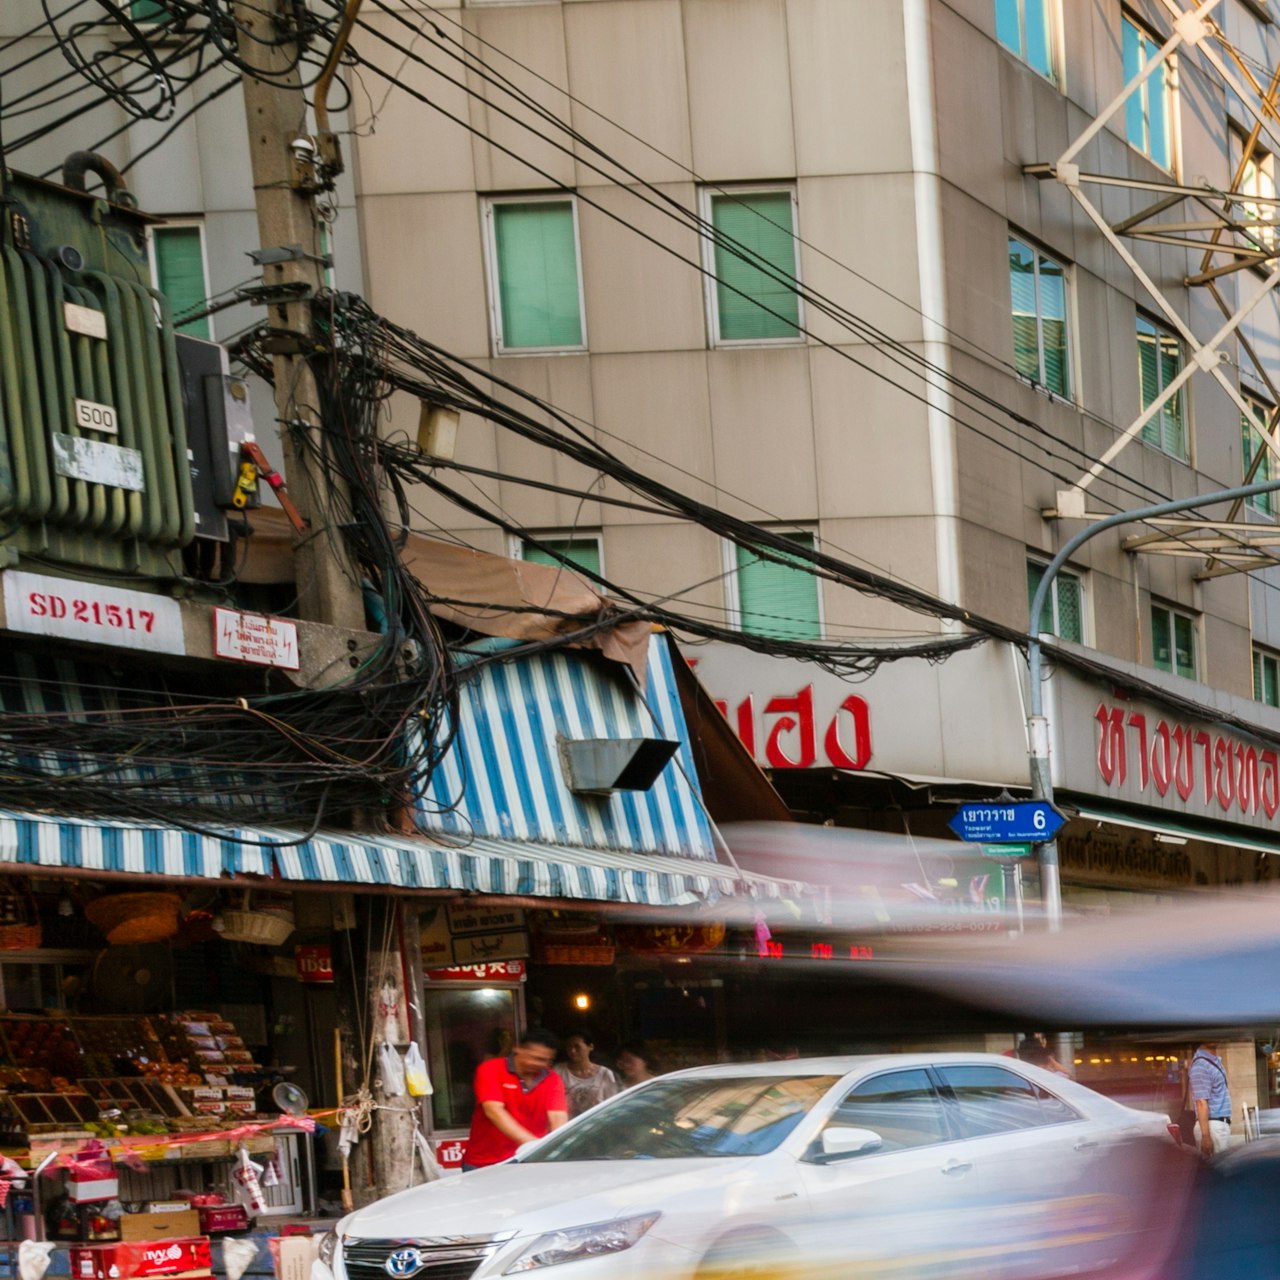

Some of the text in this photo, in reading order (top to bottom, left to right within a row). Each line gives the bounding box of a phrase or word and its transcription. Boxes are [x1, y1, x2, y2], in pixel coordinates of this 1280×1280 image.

[80, 405, 113, 427] 500
[29, 592, 155, 633] SD 21517
[713, 683, 872, 769] เฮง
[963, 808, 1046, 829] เยาวราช 6
